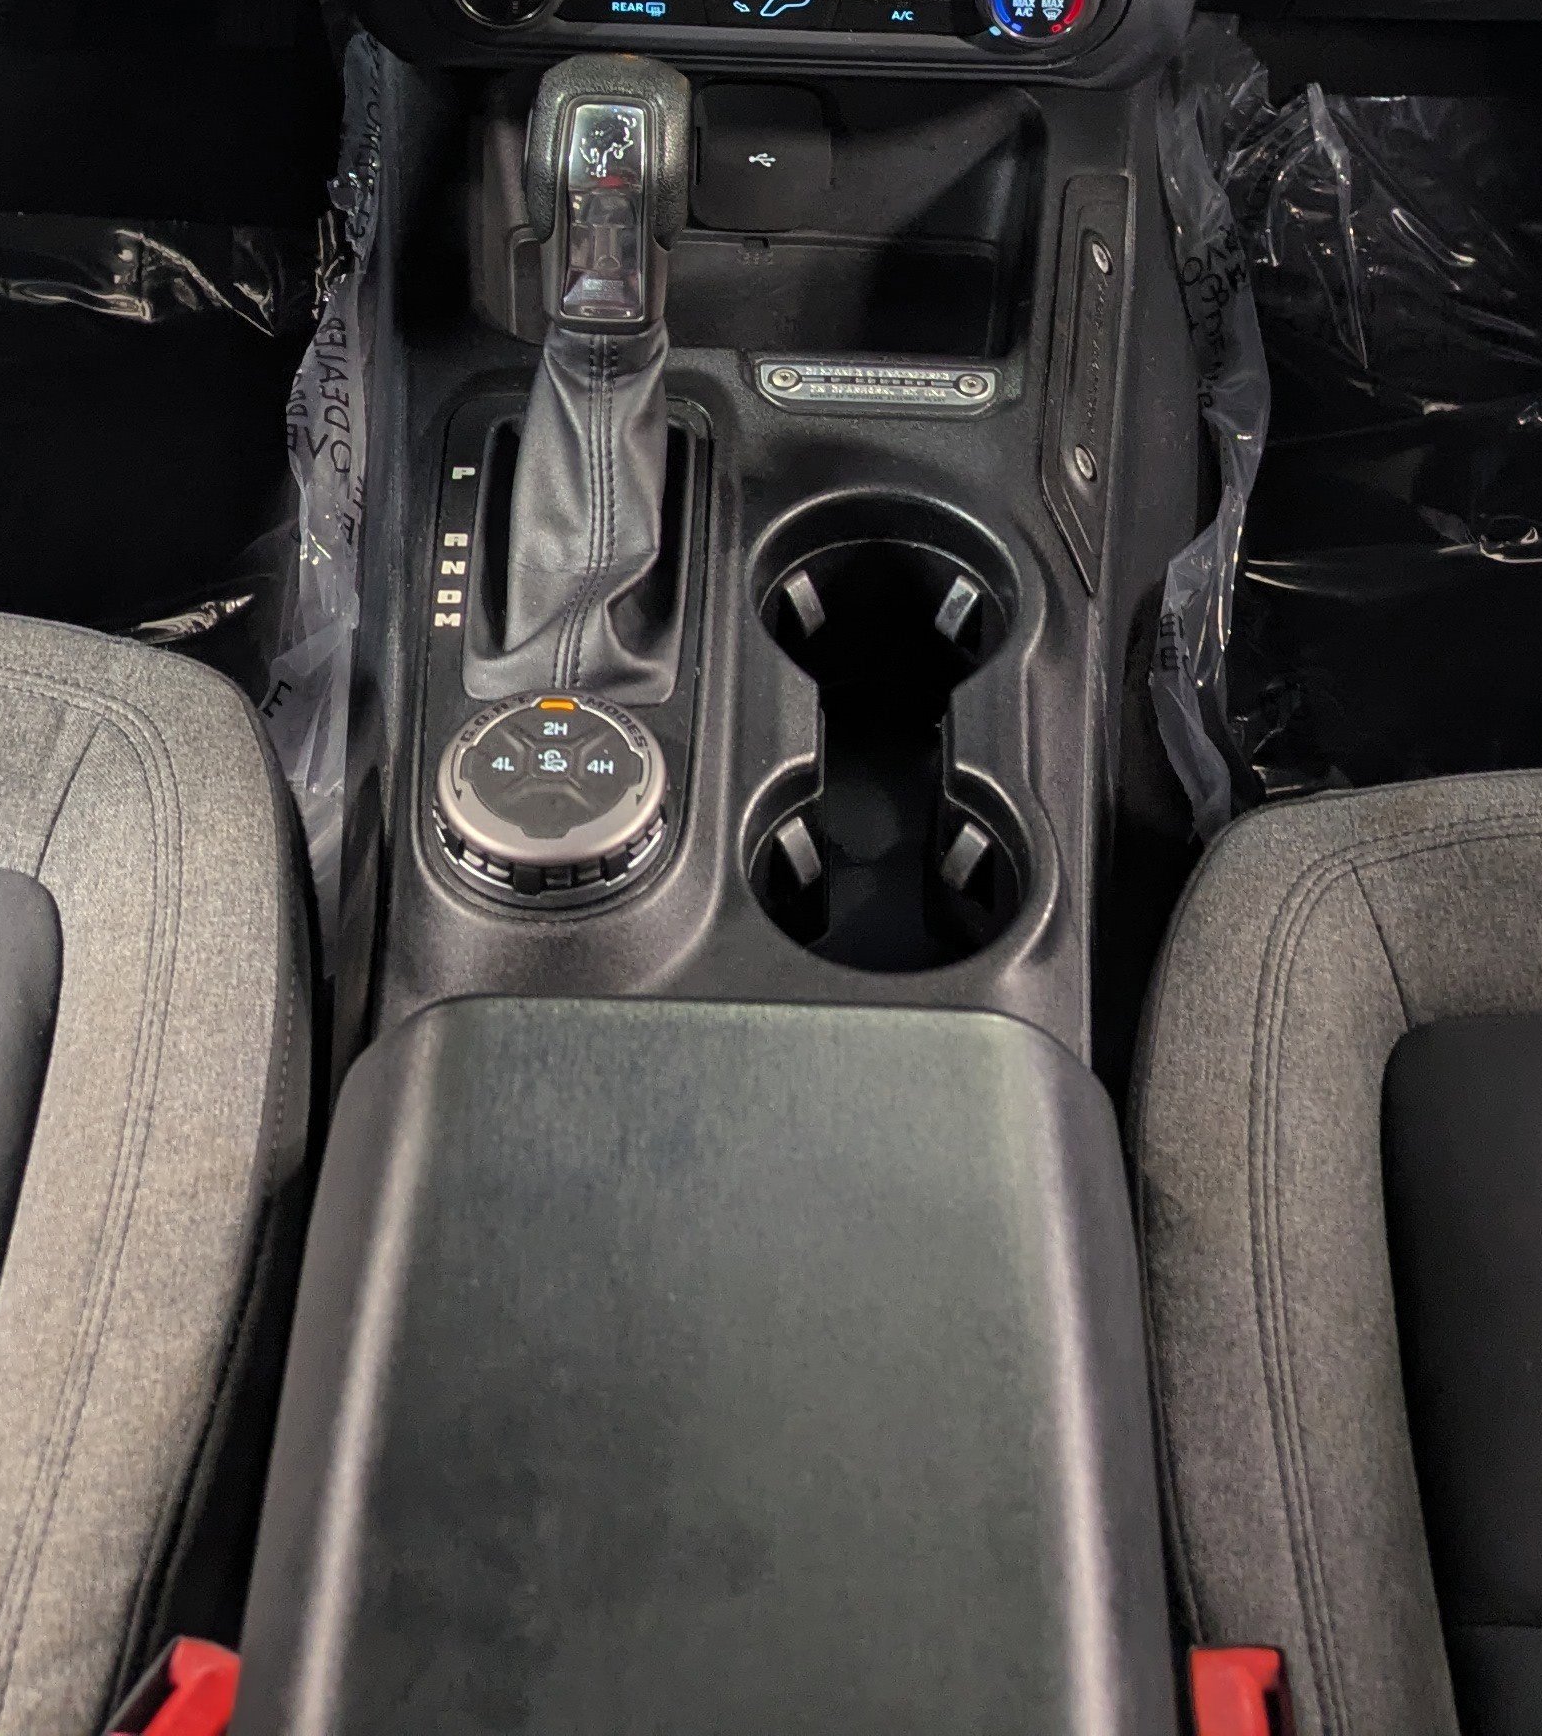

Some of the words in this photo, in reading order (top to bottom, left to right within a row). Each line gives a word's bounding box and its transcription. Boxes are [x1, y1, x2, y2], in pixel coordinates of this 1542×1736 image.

[611, 1, 644, 13] REAR
[1015, 7, 1034, 18] A/C
[891, 10, 914, 22] A/C
[452, 466, 476, 480] P
[441, 560, 466, 575] N
[434, 612, 461, 627] M
[542, 720, 569, 737] 2H
[490, 755, 516, 773] 4L
[586, 758, 615, 776] 4H
